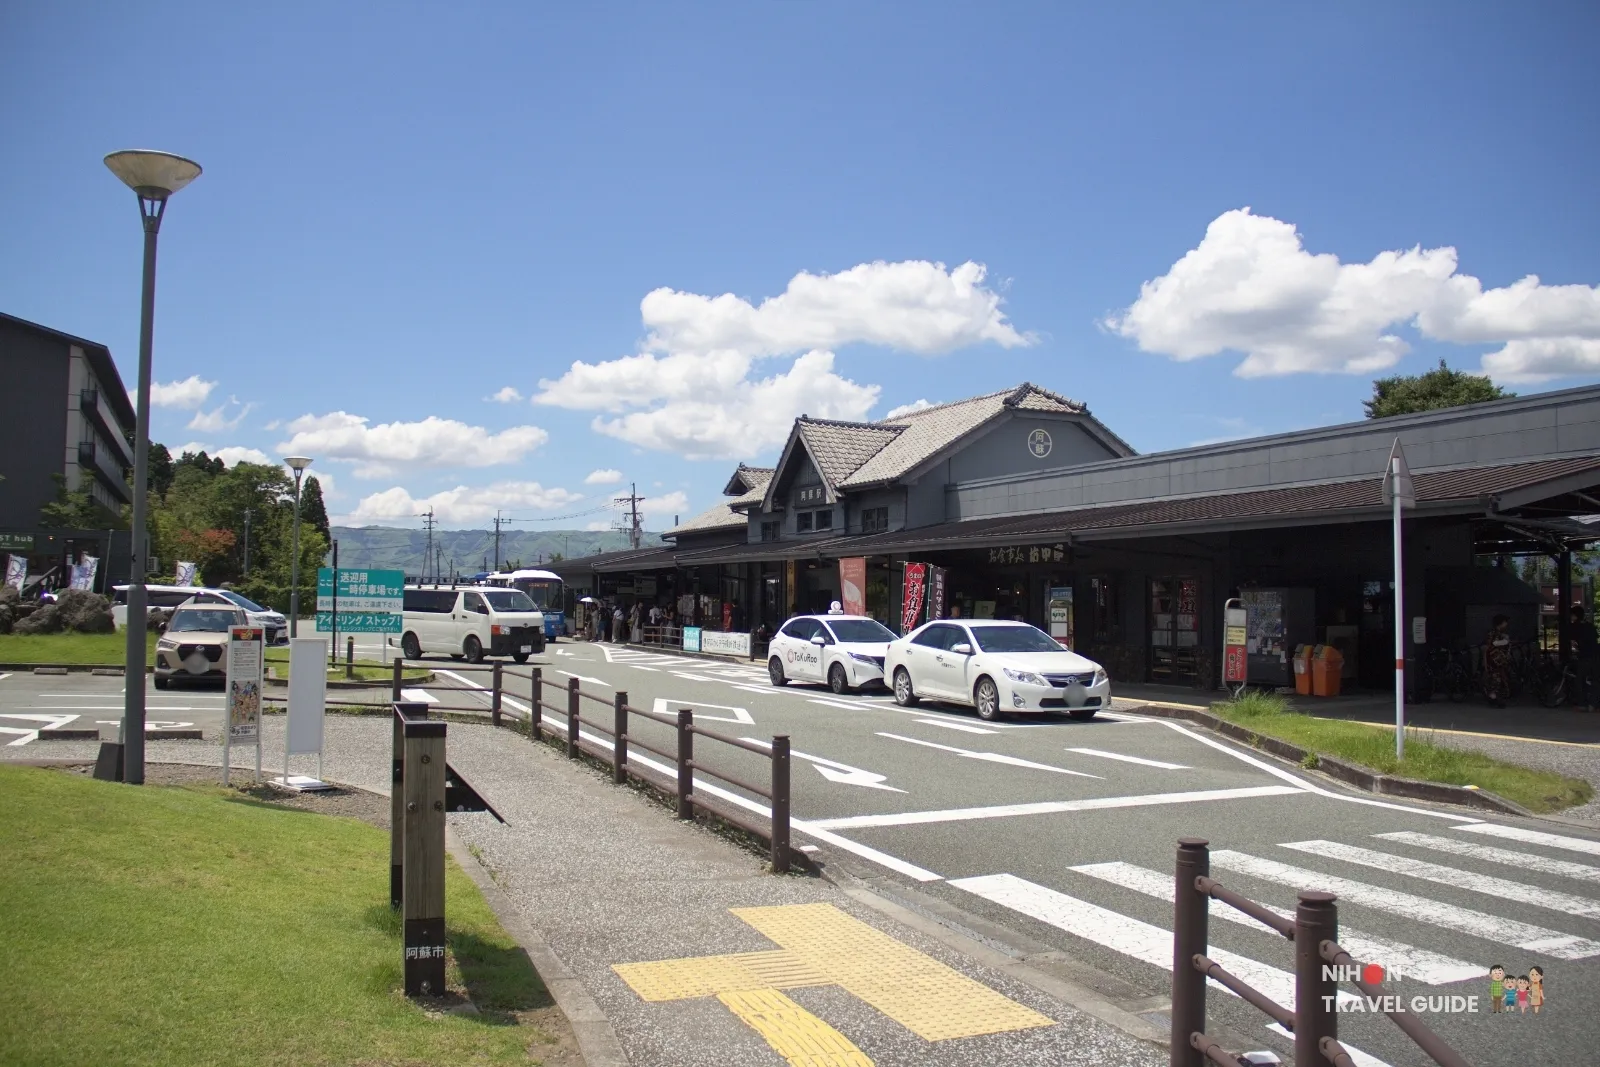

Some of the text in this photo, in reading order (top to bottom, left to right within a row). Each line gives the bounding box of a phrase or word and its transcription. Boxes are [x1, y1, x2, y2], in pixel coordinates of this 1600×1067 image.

[1035, 431, 1045, 454] 阿蘇
[15, 534, 33, 542] hub
[340, 572, 368, 583] 送迎用
[340, 584, 402, 596] 一時停車場です。
[319, 600, 401, 608] 長時の駐車は、ご遠慮下さい。
[405, 945, 445, 960] 阿蘇市
